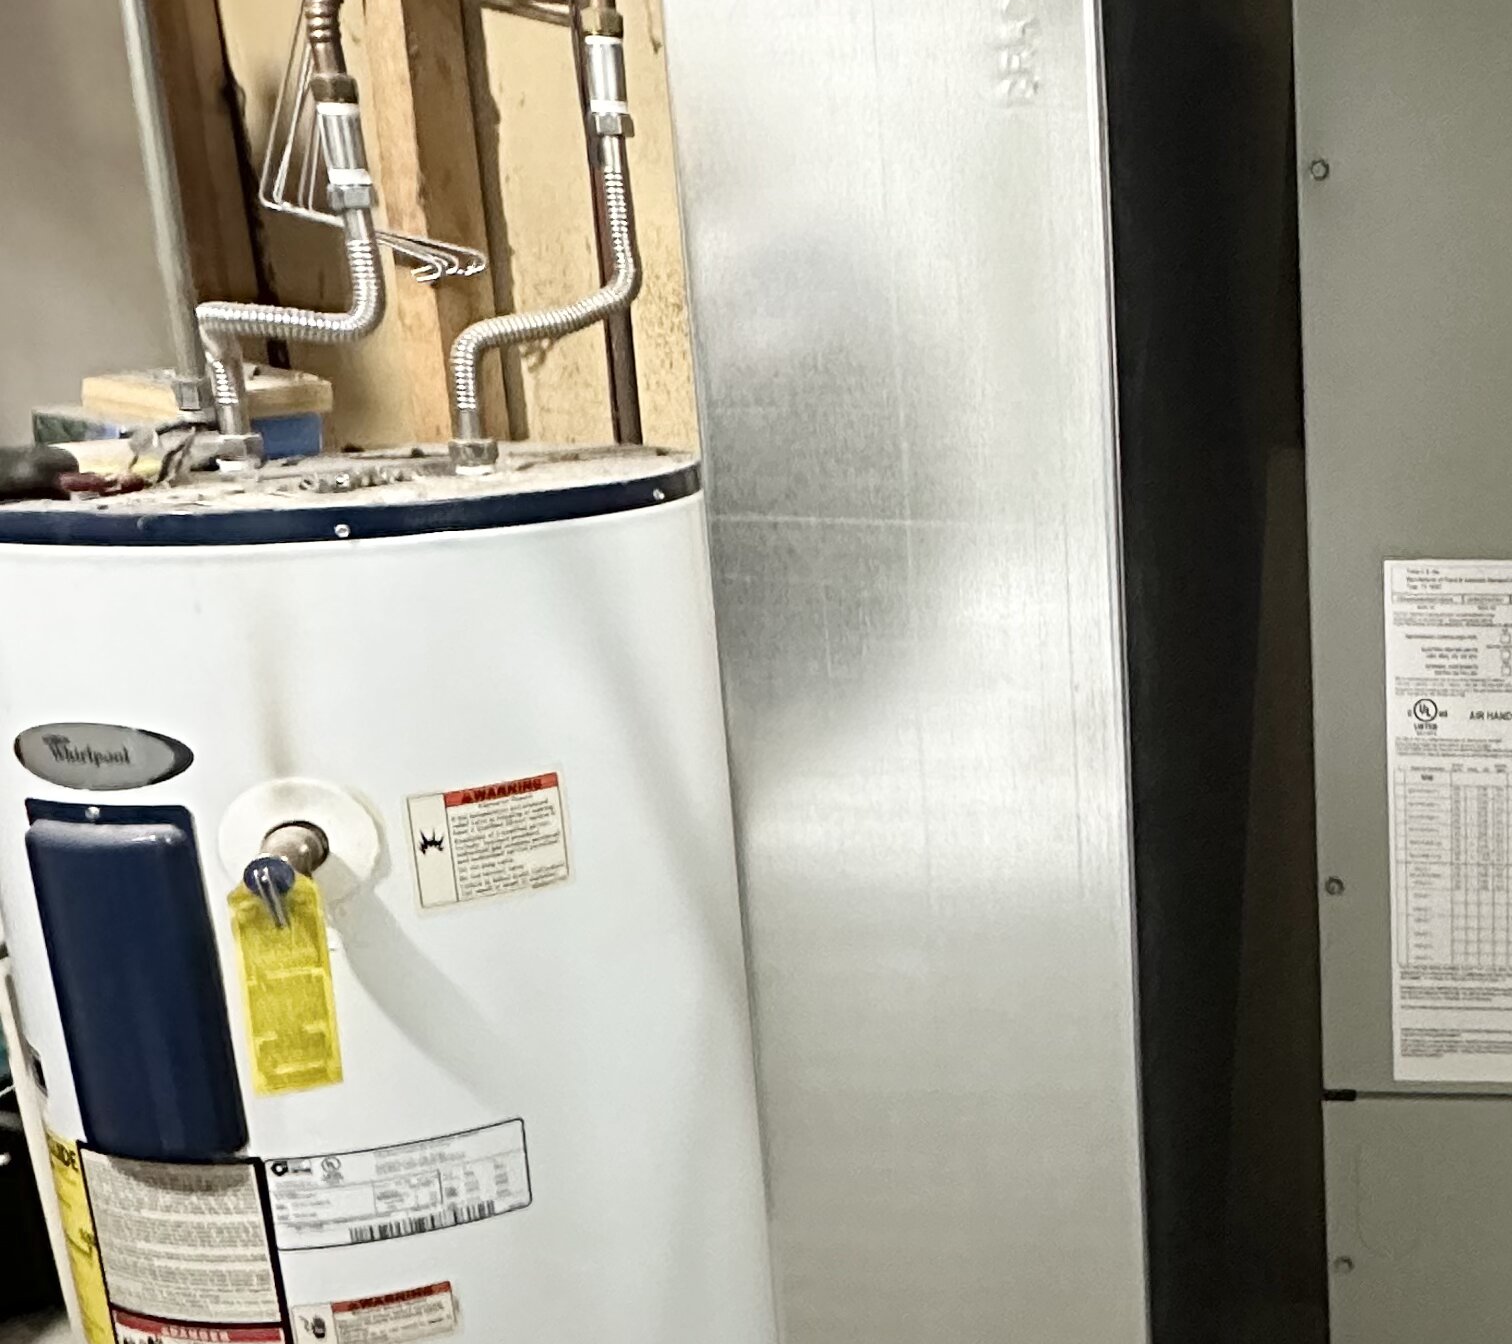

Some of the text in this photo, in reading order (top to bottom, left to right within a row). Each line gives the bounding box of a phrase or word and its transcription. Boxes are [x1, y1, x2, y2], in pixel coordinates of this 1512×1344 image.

[1469, 711, 1484, 720] AIR
[48, 739, 131, 768] Whirlpool
[473, 779, 542, 800] WARNING
